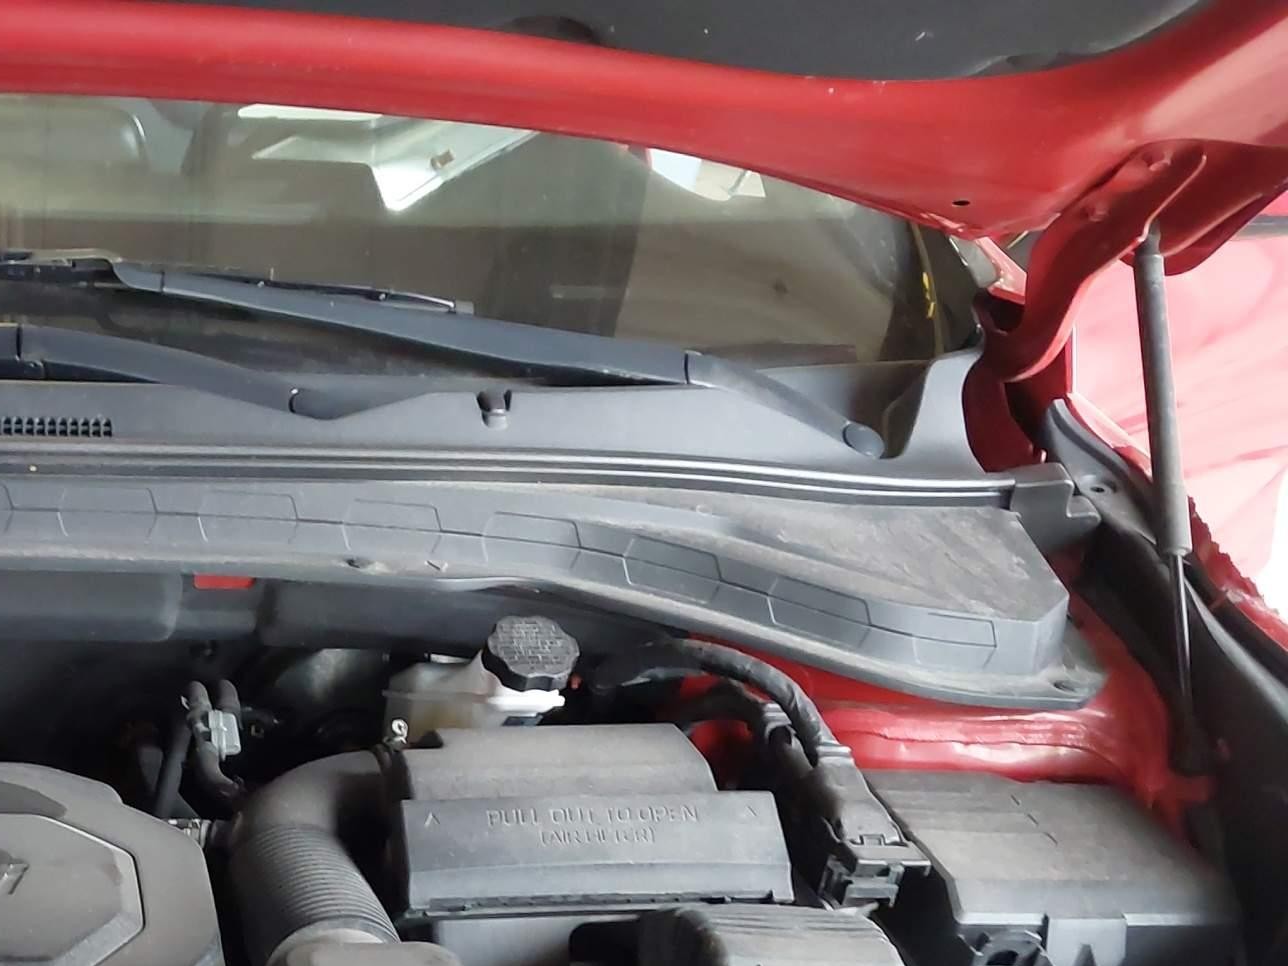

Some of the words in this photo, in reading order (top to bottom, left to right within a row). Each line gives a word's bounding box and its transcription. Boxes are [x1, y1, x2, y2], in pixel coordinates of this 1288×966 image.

[486, 808, 539, 827] PULL
[549, 807, 594, 825] OUT
[607, 806, 632, 823] TO
[637, 803, 700, 823] OPEN
